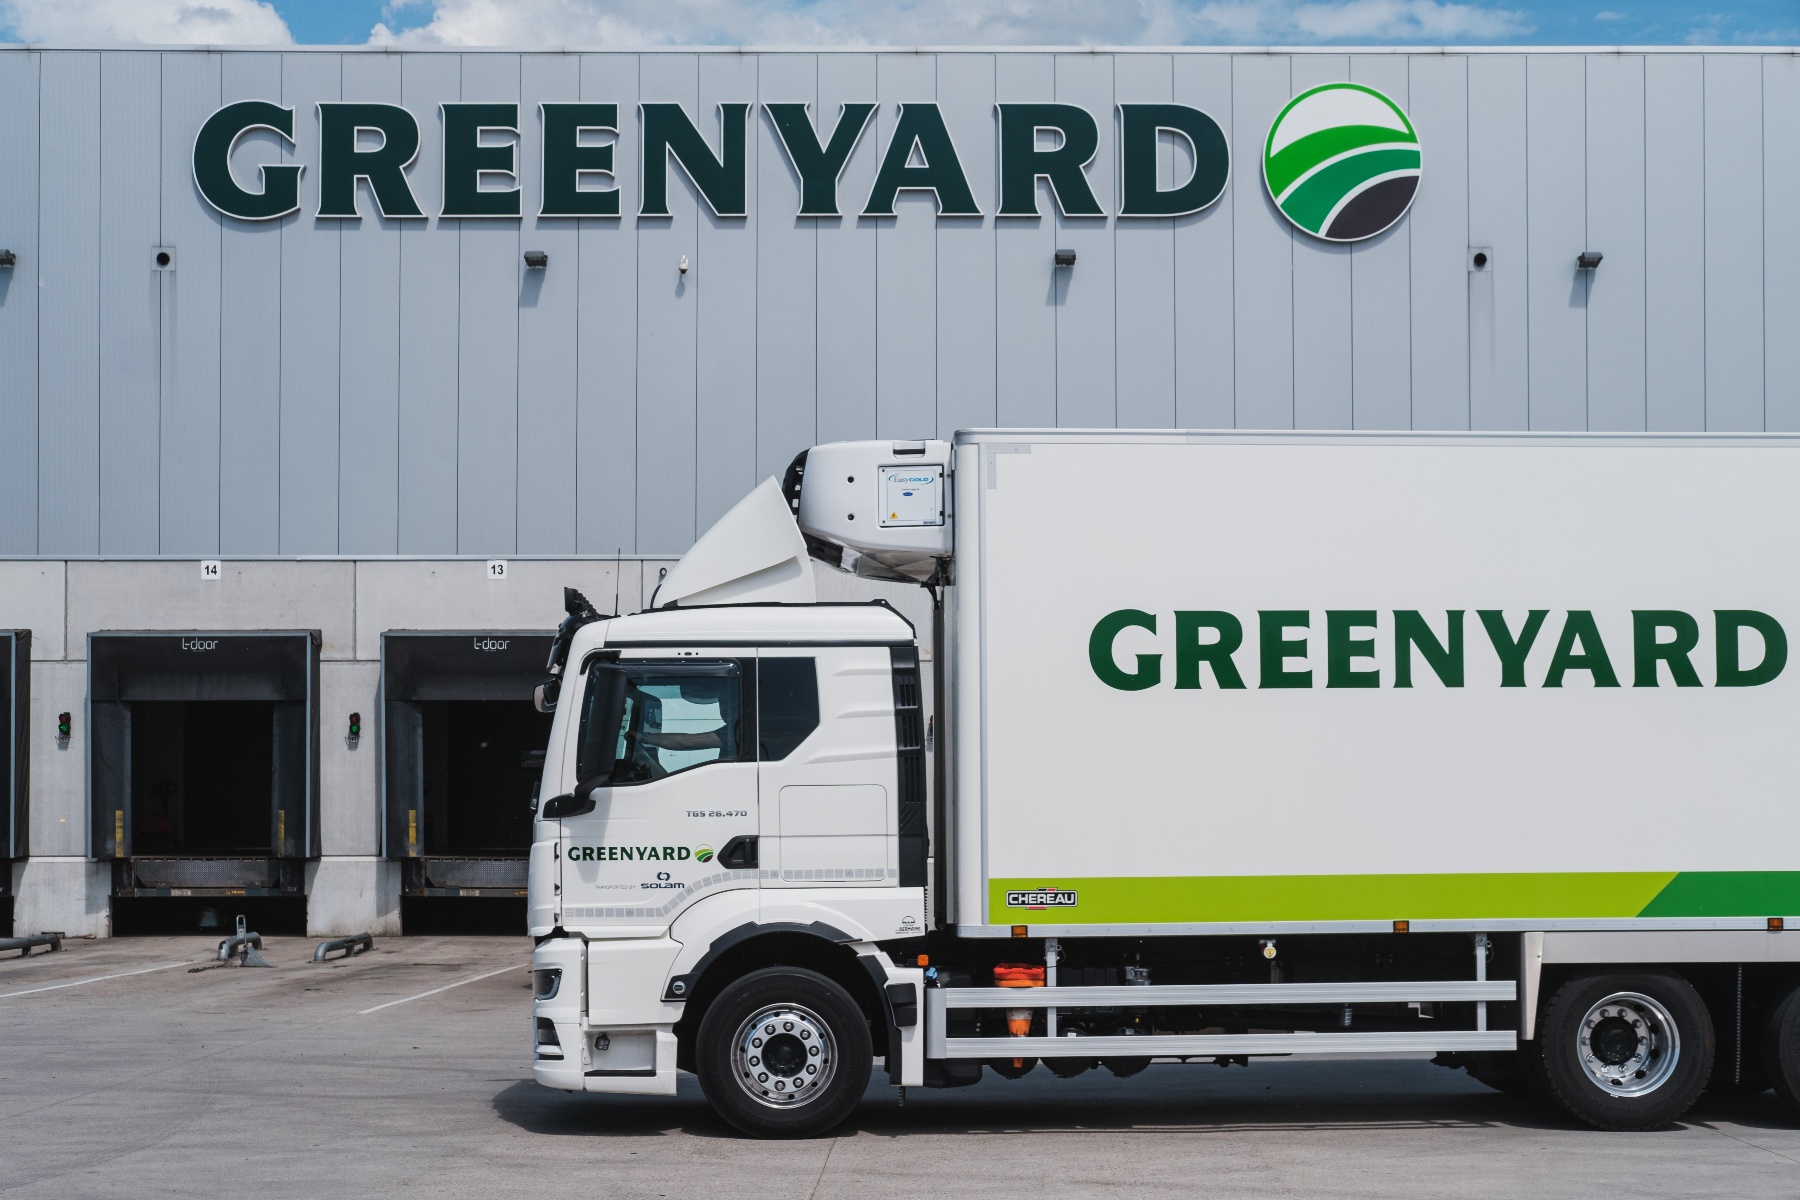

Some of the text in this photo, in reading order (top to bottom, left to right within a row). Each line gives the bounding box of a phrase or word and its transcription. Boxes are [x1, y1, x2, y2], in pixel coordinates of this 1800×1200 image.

[192, 100, 1231, 220] GREENYARD
[205, 565, 217, 575] 14
[491, 564, 504, 575] 13
[1088, 608, 1789, 692] GREENYARD
[686, 810, 706, 818] TGS
[567, 846, 691, 861] GREENYARD
[1008, 893, 1075, 904] CHEREAU
